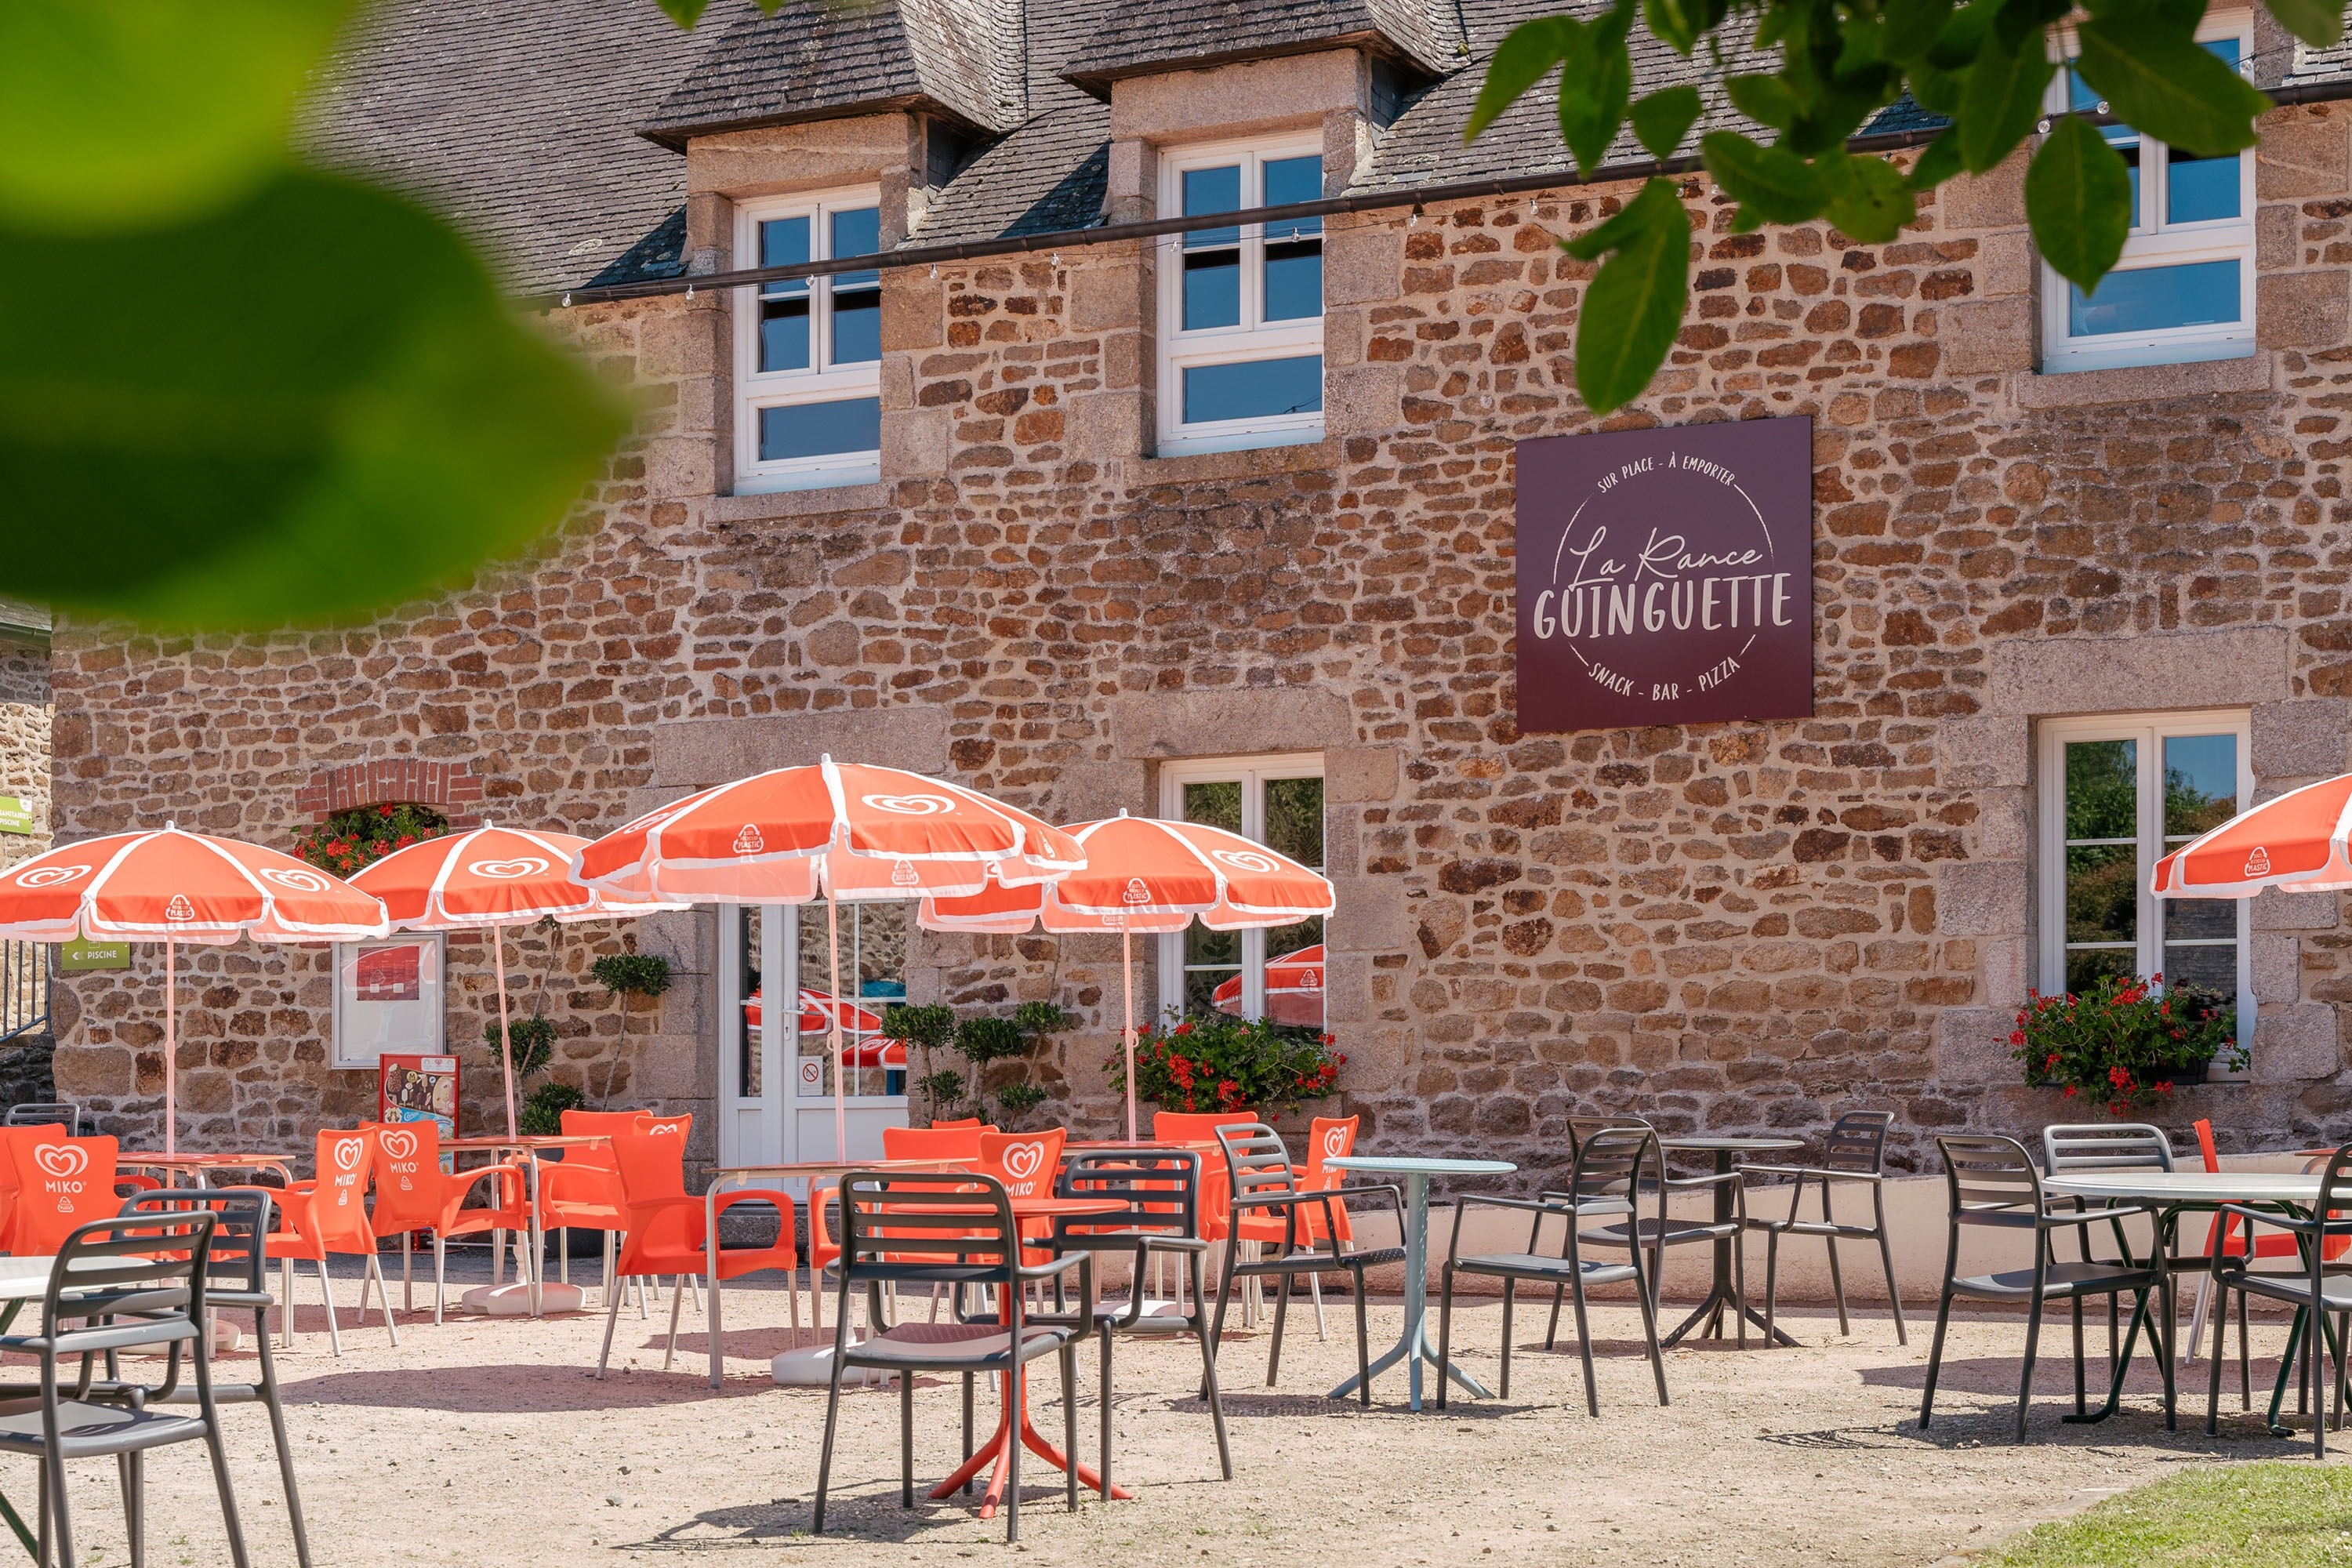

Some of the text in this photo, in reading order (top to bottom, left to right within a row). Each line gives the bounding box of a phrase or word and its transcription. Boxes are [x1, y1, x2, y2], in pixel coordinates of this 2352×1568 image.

[1597, 472, 1619, 494] SUR
[1621, 456, 1654, 479] PLACE
[1668, 451, 1676, 468] À
[1682, 456, 1735, 486] EMPORTER
[1567, 525, 1763, 592] La Rance
[1533, 572, 1792, 639] GUINGUETTE
[1588, 662, 1635, 696] SNACK
[1652, 683, 1679, 701] BAR
[1698, 656, 1740, 691] PIZZA
[87, 950, 117, 959] PISCINE
